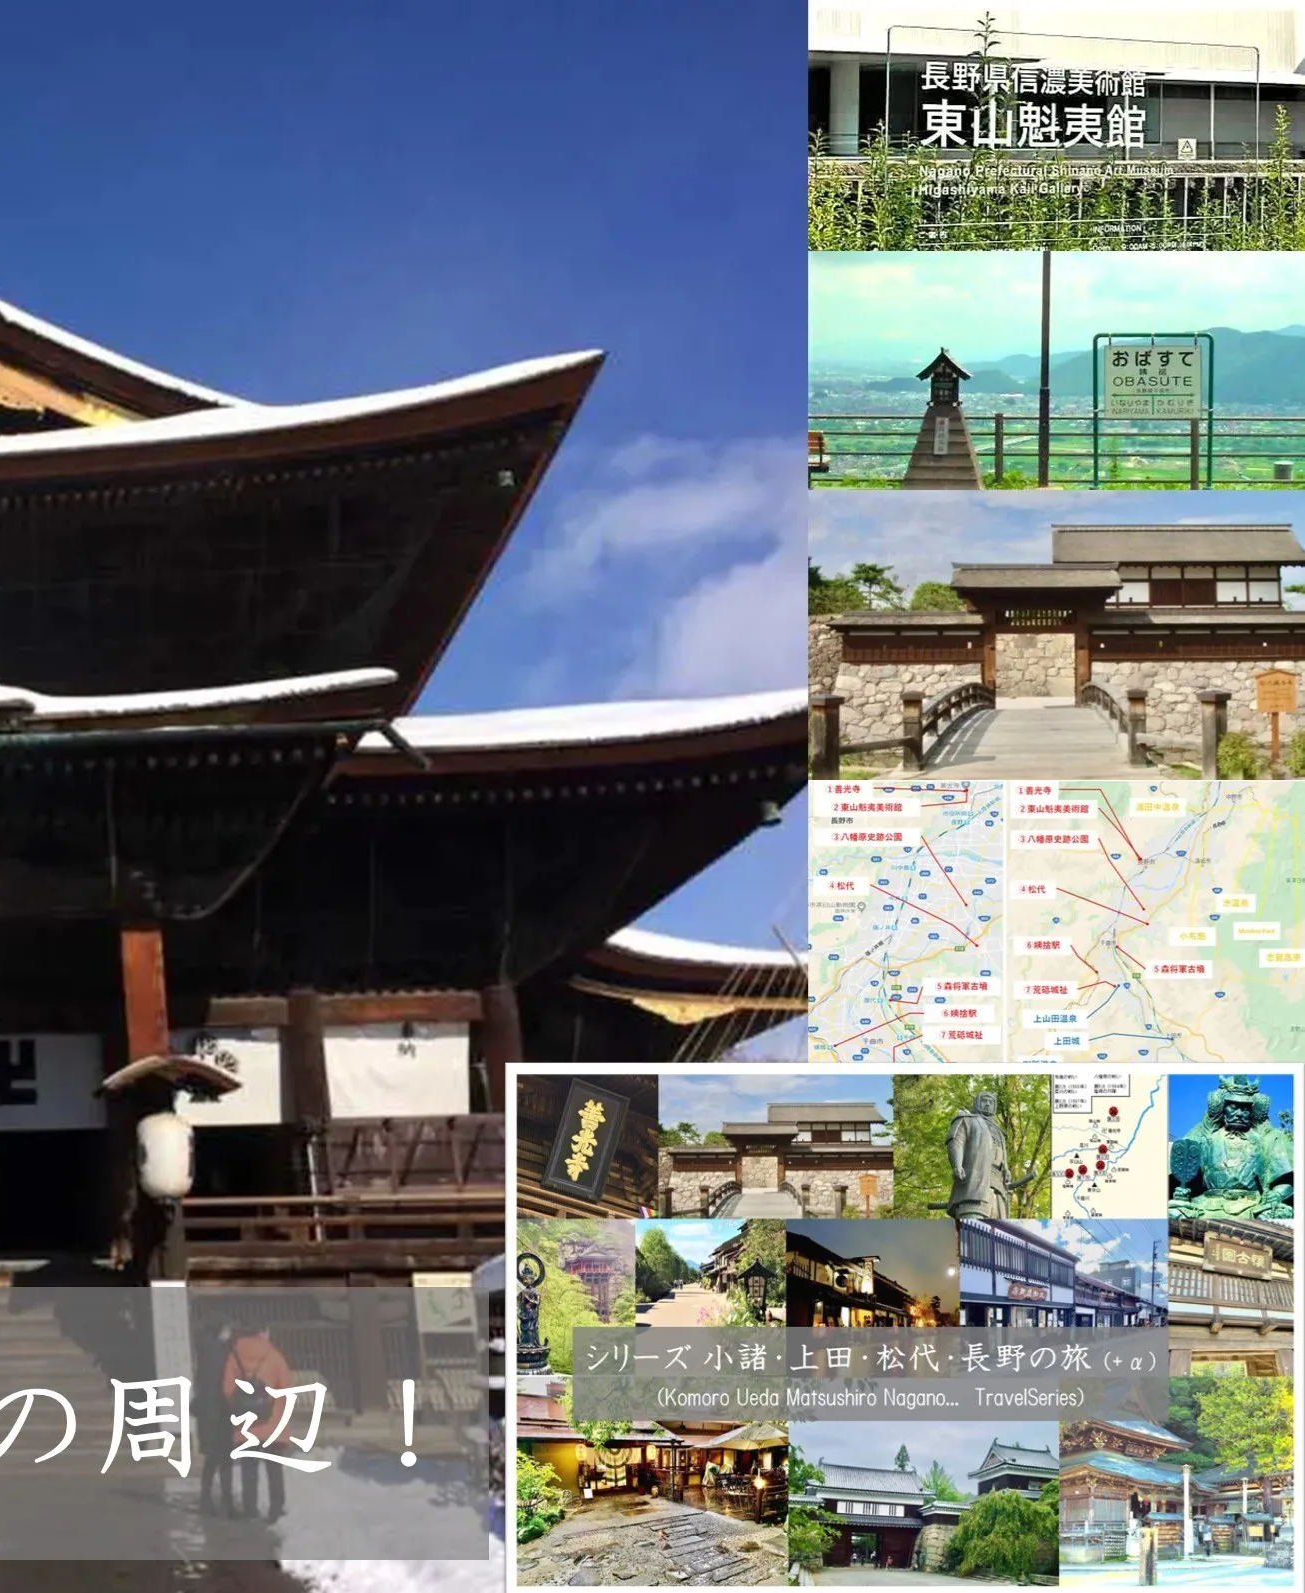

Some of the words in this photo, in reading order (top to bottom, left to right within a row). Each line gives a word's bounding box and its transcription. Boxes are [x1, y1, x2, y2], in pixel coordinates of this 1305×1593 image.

[921, 61, 1146, 97] 長野県信濃美術館
[921, 99, 1147, 148] 東山魁夷館
[919, 165, 970, 180] Nagano
[975, 164, 1047, 178] Prefectural
[1105, 164, 1123, 176] Art
[1127, 165, 1175, 176] Museum
[918, 183, 1005, 197] Higashiyama
[1038, 183, 1083, 196] Gallery
[1112, 350, 1195, 367] おばすて
[1112, 376, 1193, 387] OBASUTE
[564, 1099, 606, 1181] 善光寺
